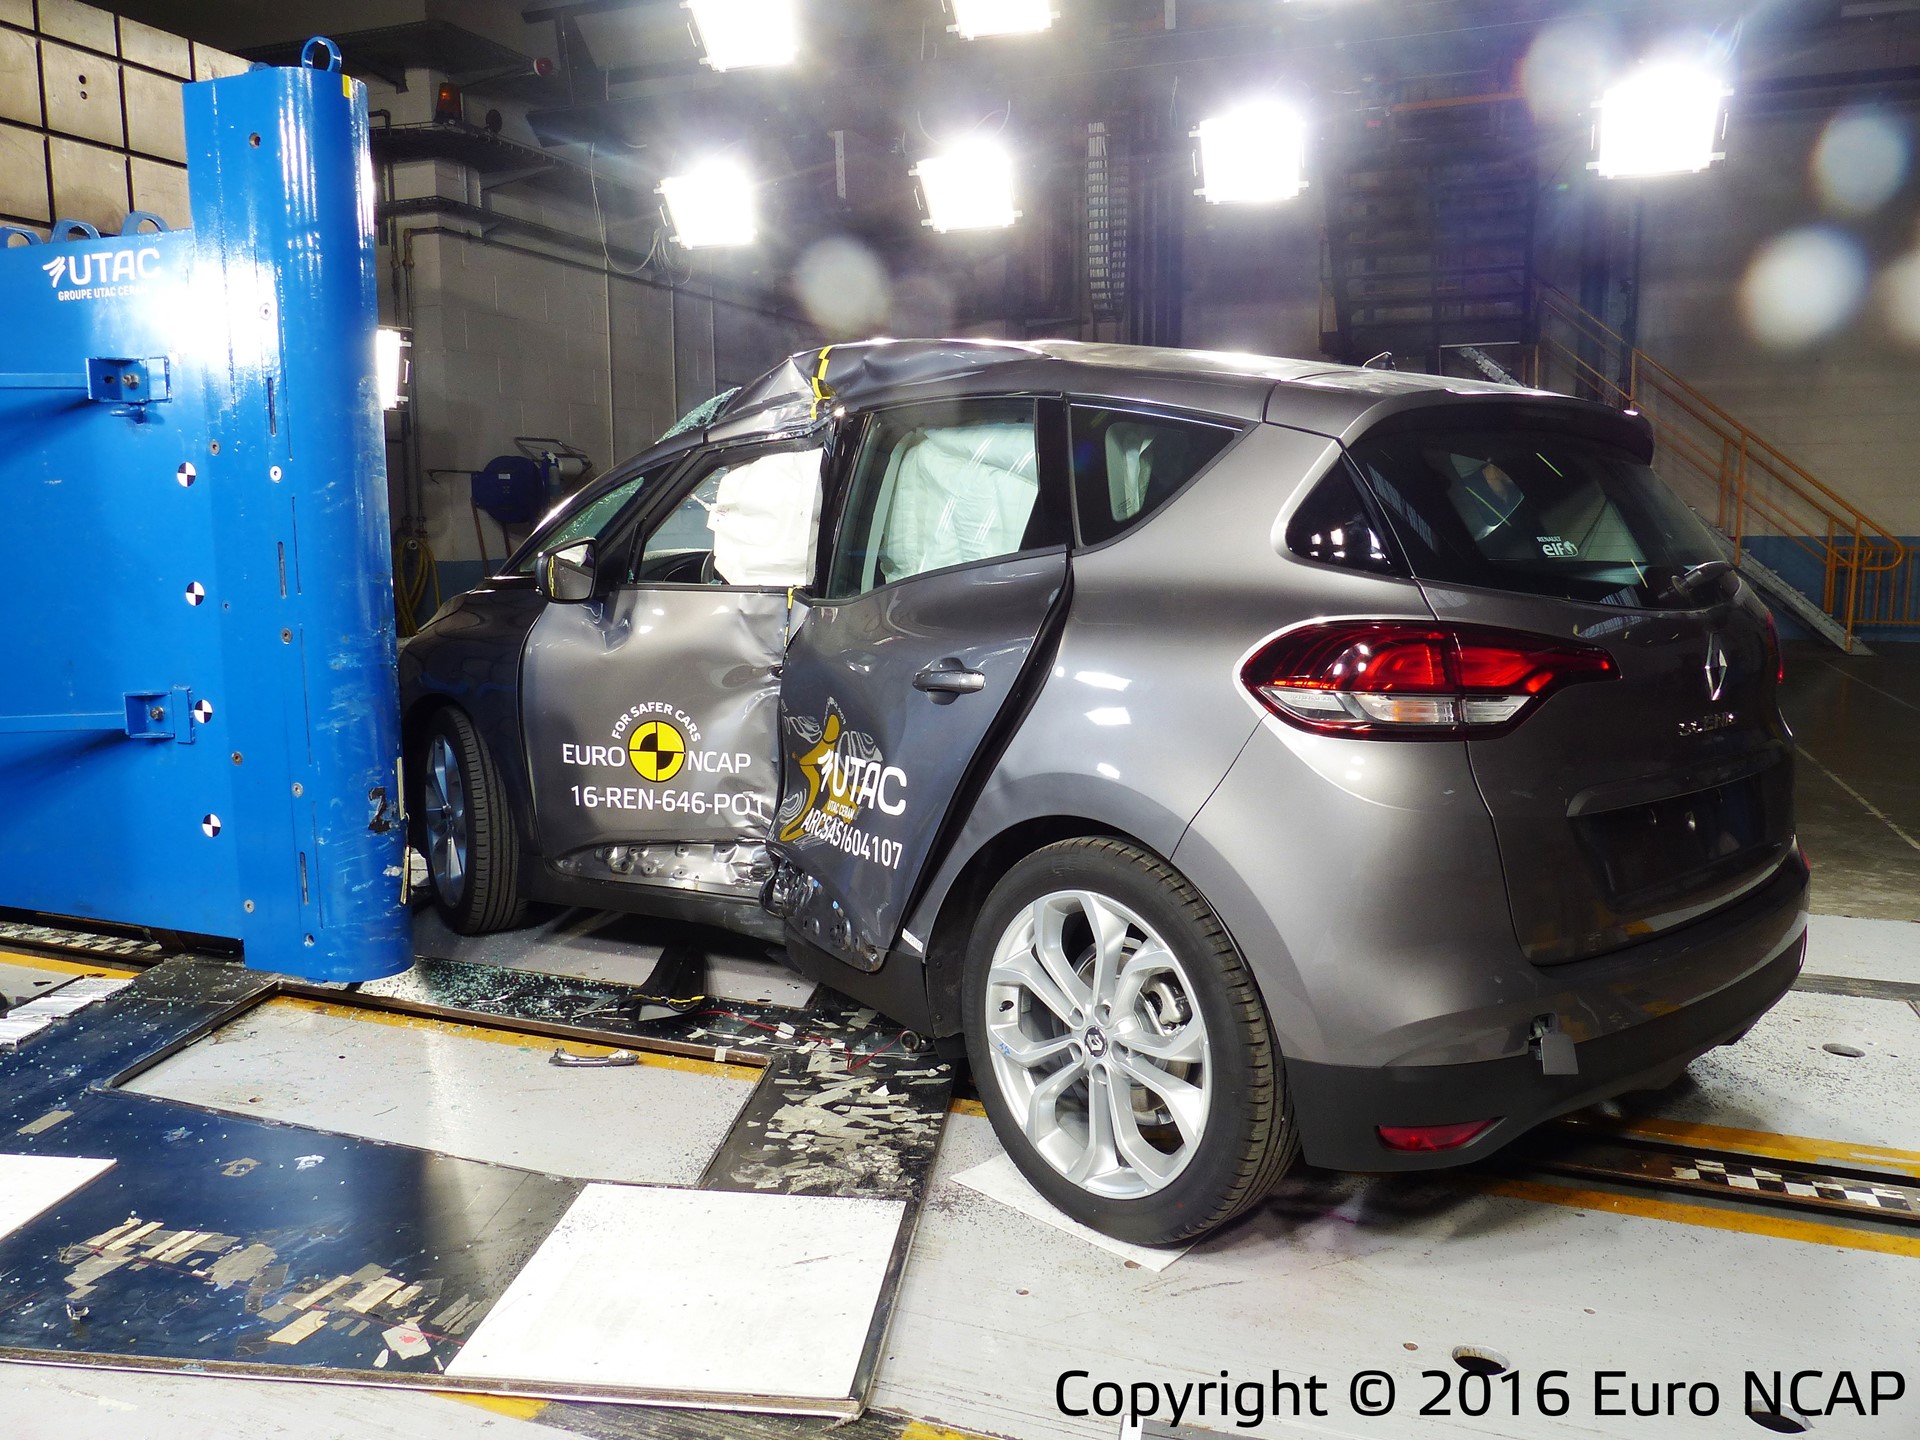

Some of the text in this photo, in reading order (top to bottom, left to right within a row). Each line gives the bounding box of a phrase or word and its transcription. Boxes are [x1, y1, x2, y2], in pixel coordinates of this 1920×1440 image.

[68, 248, 161, 285] UTAC
[58, 288, 93, 302] GROUPE
[93, 286, 117, 298] UTAC
[1542, 542, 1565, 556] elf
[611, 701, 701, 742] FOR SAFER CARS
[562, 743, 751, 774] EURO NCAP
[832, 752, 907, 816] UTAC
[801, 807, 903, 870] ARCSAS1604107
